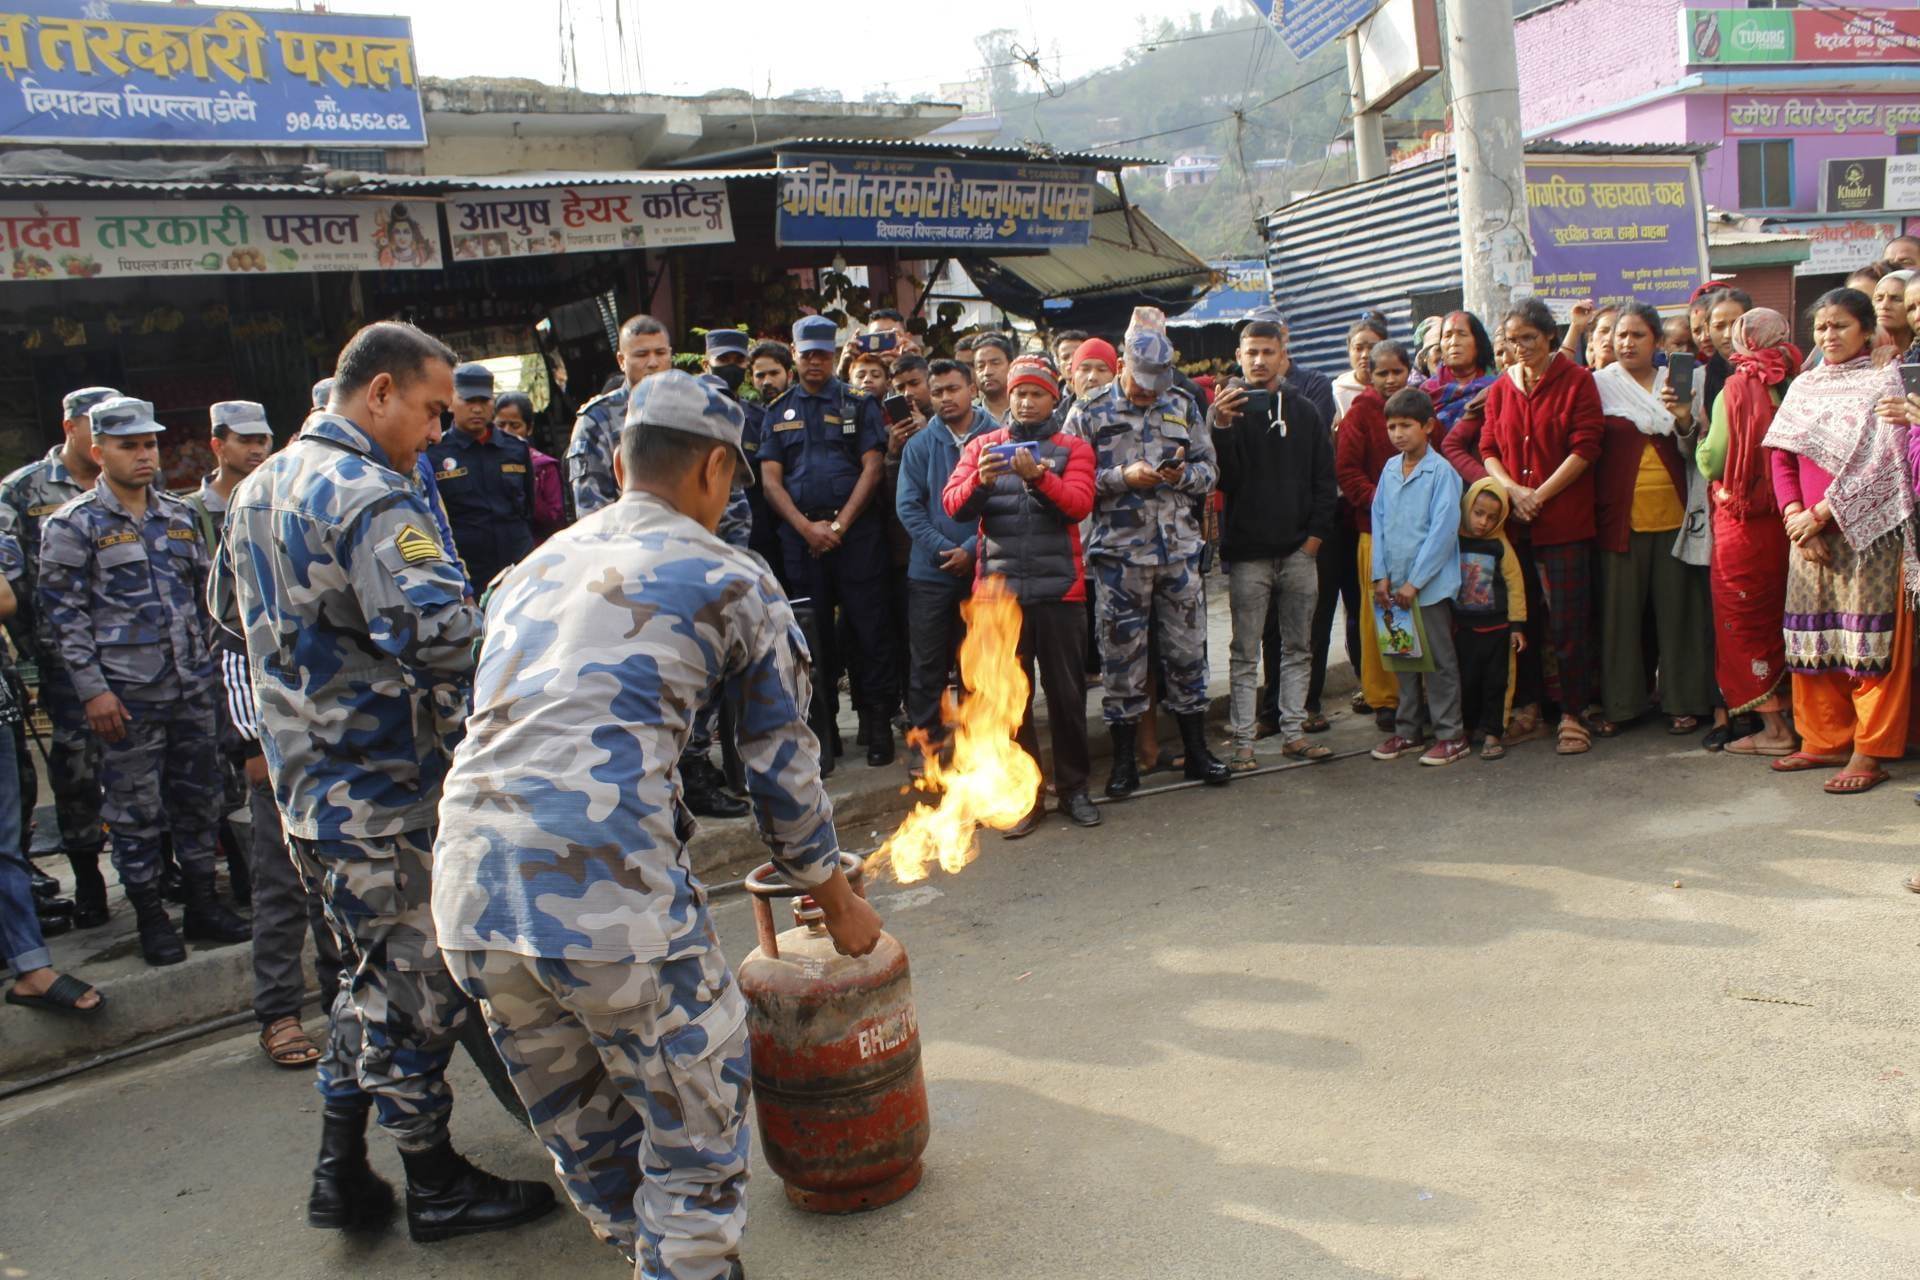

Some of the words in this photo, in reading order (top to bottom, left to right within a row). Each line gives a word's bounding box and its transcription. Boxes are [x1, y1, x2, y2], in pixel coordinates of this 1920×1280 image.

[38, 12, 271, 84] तरकारी
[275, 30, 413, 90] पसल
[1739, 28, 1785, 45] TUBORG
[286, 112, 411, 132] 9848456262
[1730, 98, 1780, 127] रमेश
[1784, 98, 1816, 126] दिप
[1837, 185, 1872, 200] Khukri
[95, 204, 250, 250] तरकारी
[262, 213, 360, 246] पसल
[455, 200, 551, 236] आयुष
[560, 189, 633, 228] हेयर
